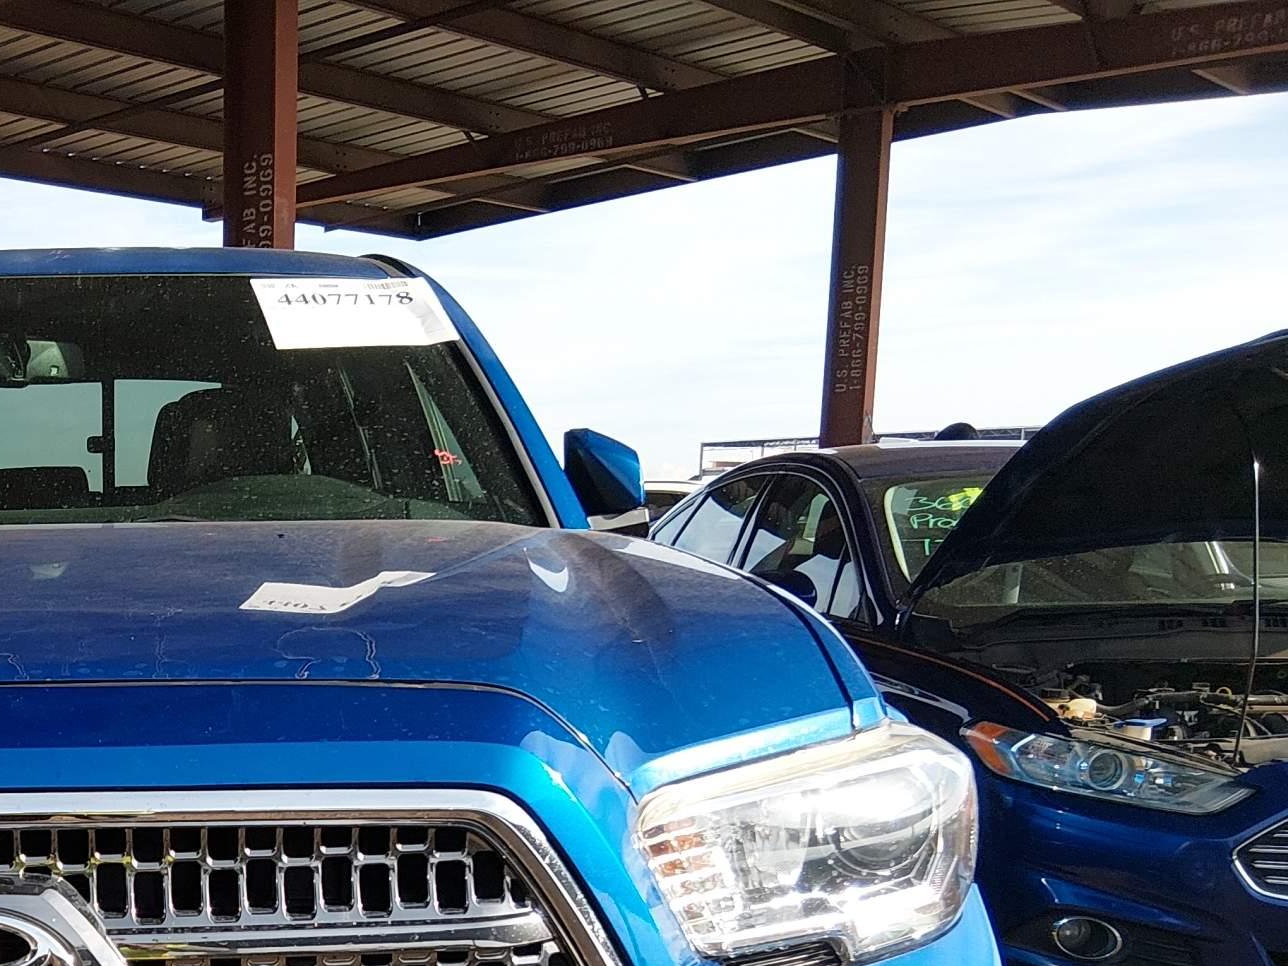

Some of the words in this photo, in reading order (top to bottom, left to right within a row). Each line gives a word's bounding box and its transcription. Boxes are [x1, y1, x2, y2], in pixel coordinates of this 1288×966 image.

[243, 154, 258, 196] INC.
[842, 264, 857, 293] INC.
[278, 291, 414, 306] 44077178
[839, 301, 854, 358] PREFAB
[849, 265, 869, 391] 1-866-799-0969
[834, 365, 850, 393] U.S.
